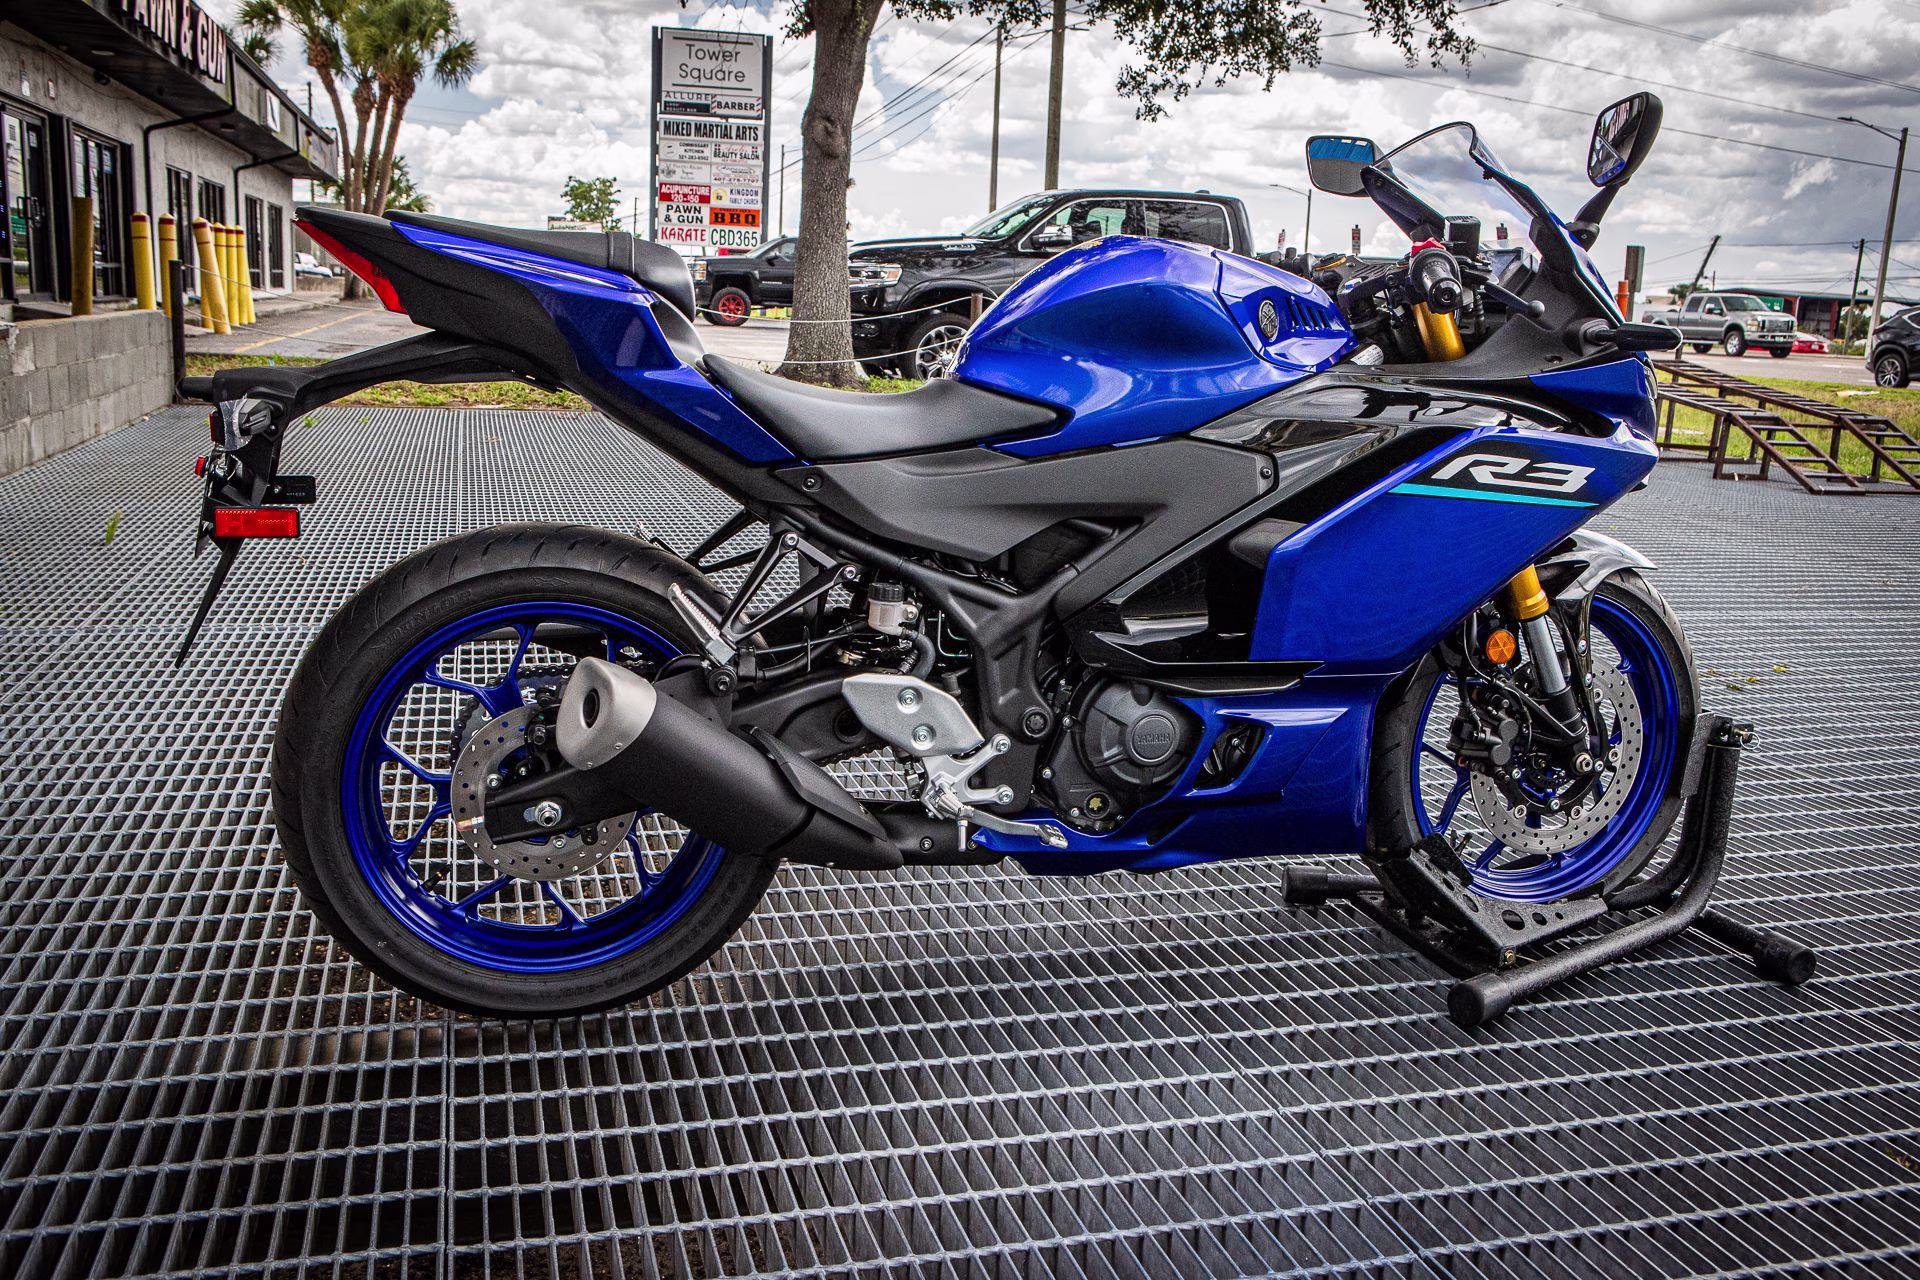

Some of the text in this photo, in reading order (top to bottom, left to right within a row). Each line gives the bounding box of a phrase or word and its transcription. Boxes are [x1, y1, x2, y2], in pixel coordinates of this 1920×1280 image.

[121, 0, 227, 85] WN & GUN
[685, 43, 741, 63] Tower
[679, 63, 746, 83] Square
[664, 91, 711, 102] ALLURE
[716, 100, 756, 112] BARBER
[663, 120, 759, 142] MIXED MARTIAL ARTS
[713, 150, 738, 160] BEAUTY
[739, 152, 760, 161] SALON
[661, 184, 711, 196] ACUPUNCTURE
[729, 188, 759, 197] KINGDOM
[743, 197, 759, 206] CHURCH
[666, 204, 702, 215] PAWN
[664, 214, 704, 224] & GUN
[713, 211, 757, 226] BBQ
[661, 226, 707, 243] KARATE
[710, 228, 758, 248] CBD365
[1430, 453, 1596, 494] R3
[1136, 733, 1171, 745] YAMAHA
